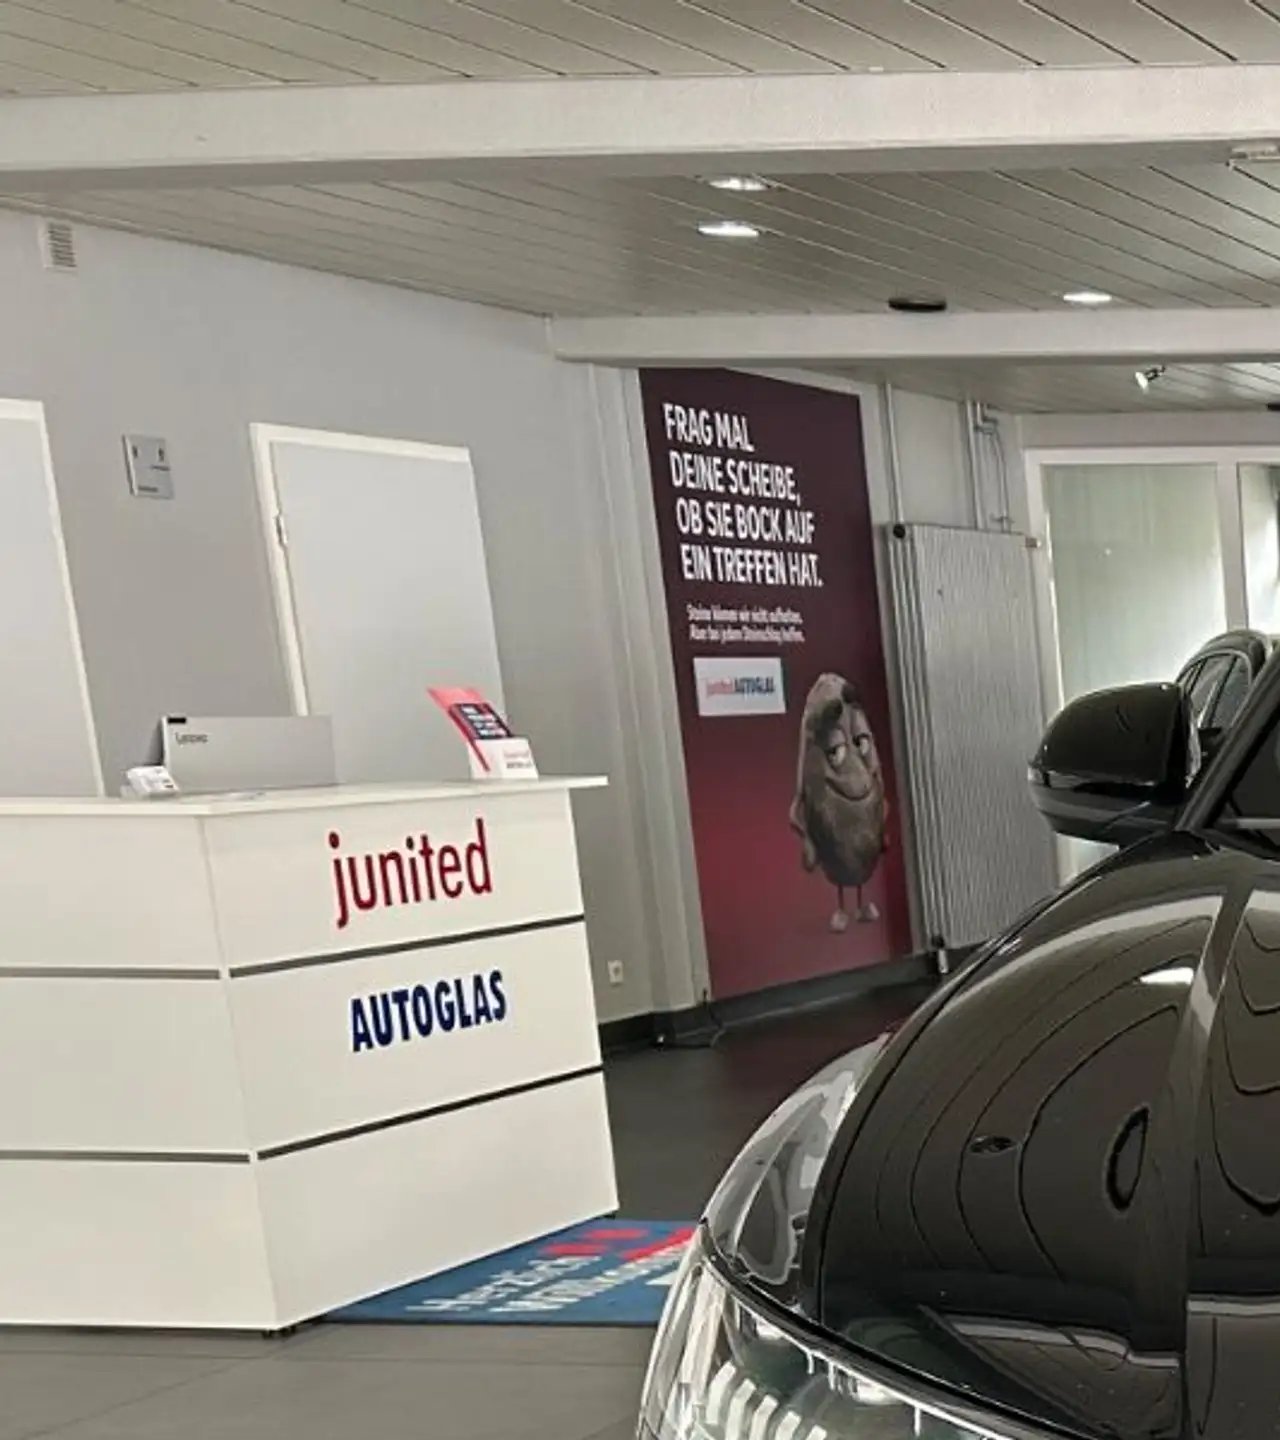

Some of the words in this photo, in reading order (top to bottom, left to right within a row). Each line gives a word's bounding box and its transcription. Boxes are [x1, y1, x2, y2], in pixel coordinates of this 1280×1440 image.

[663, 402, 713, 446] FRAG
[714, 411, 755, 452] MAL
[669, 450, 725, 493] DEINE
[726, 458, 800, 505] SCHEIBE,
[676, 497, 703, 534] OB
[705, 501, 734, 538] SIE
[734, 504, 783, 541] BOCK
[785, 509, 815, 544] AUF
[680, 543, 712, 581] EIN
[713, 546, 787, 585] TREFFEN
[788, 551, 824, 587] HAT.
[328, 817, 492, 929] junited
[351, 970, 506, 1052] AUTOGLAS
